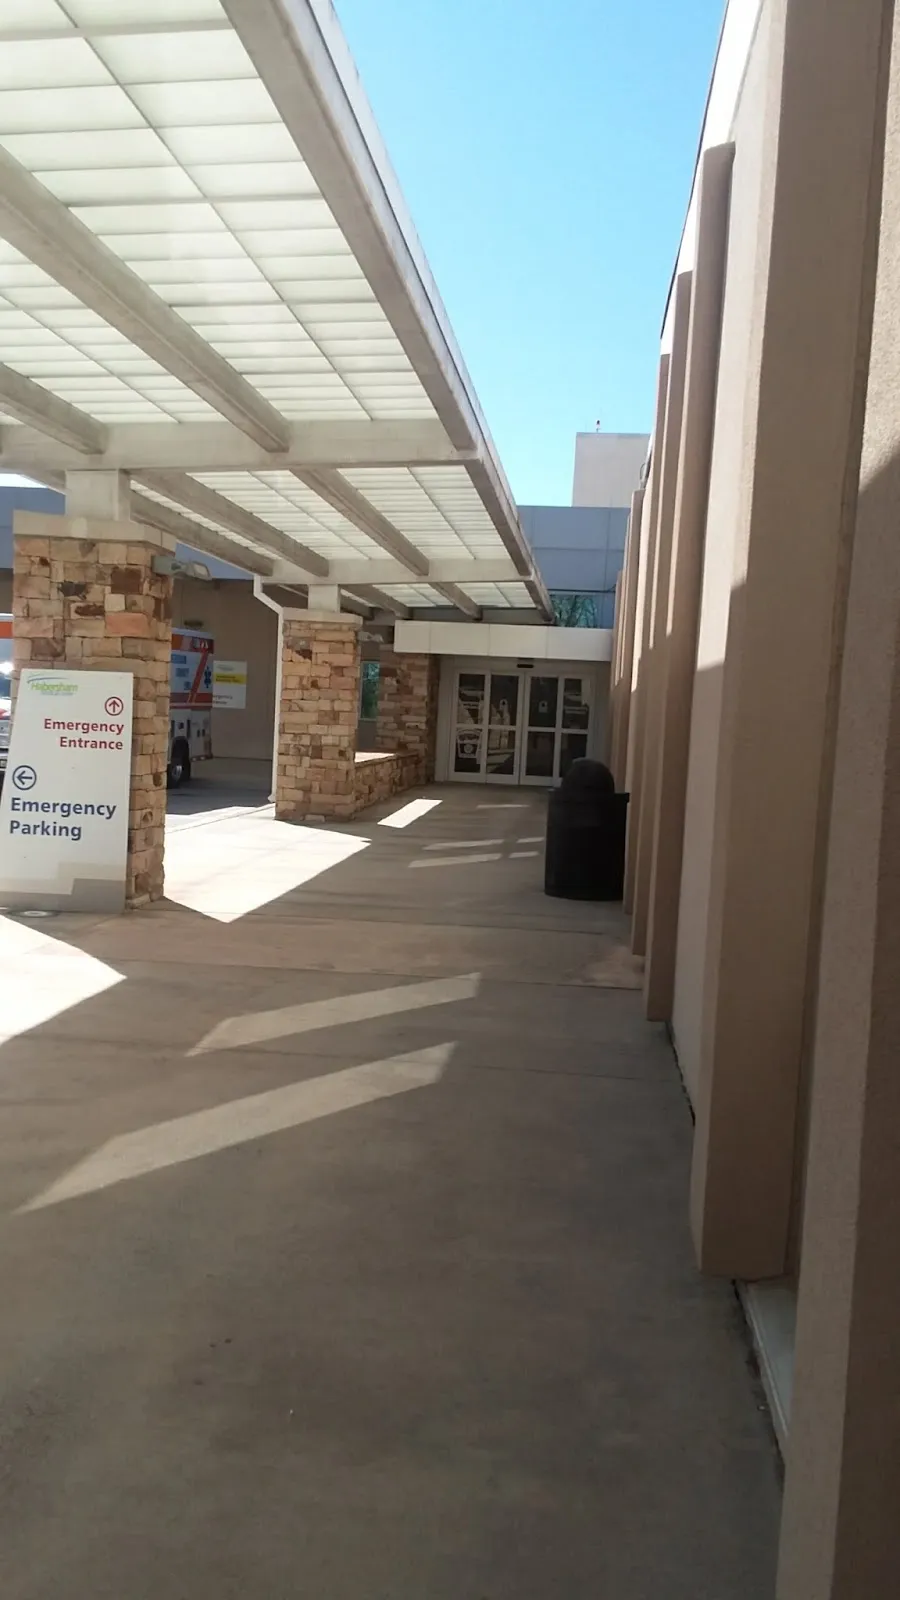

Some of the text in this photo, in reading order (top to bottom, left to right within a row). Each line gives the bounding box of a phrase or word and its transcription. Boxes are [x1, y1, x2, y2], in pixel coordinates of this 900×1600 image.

[44, 718, 124, 735] Emergency
[60, 736, 123, 750] Entrance
[11, 797, 116, 820] Emergency
[10, 821, 82, 841] Parking
